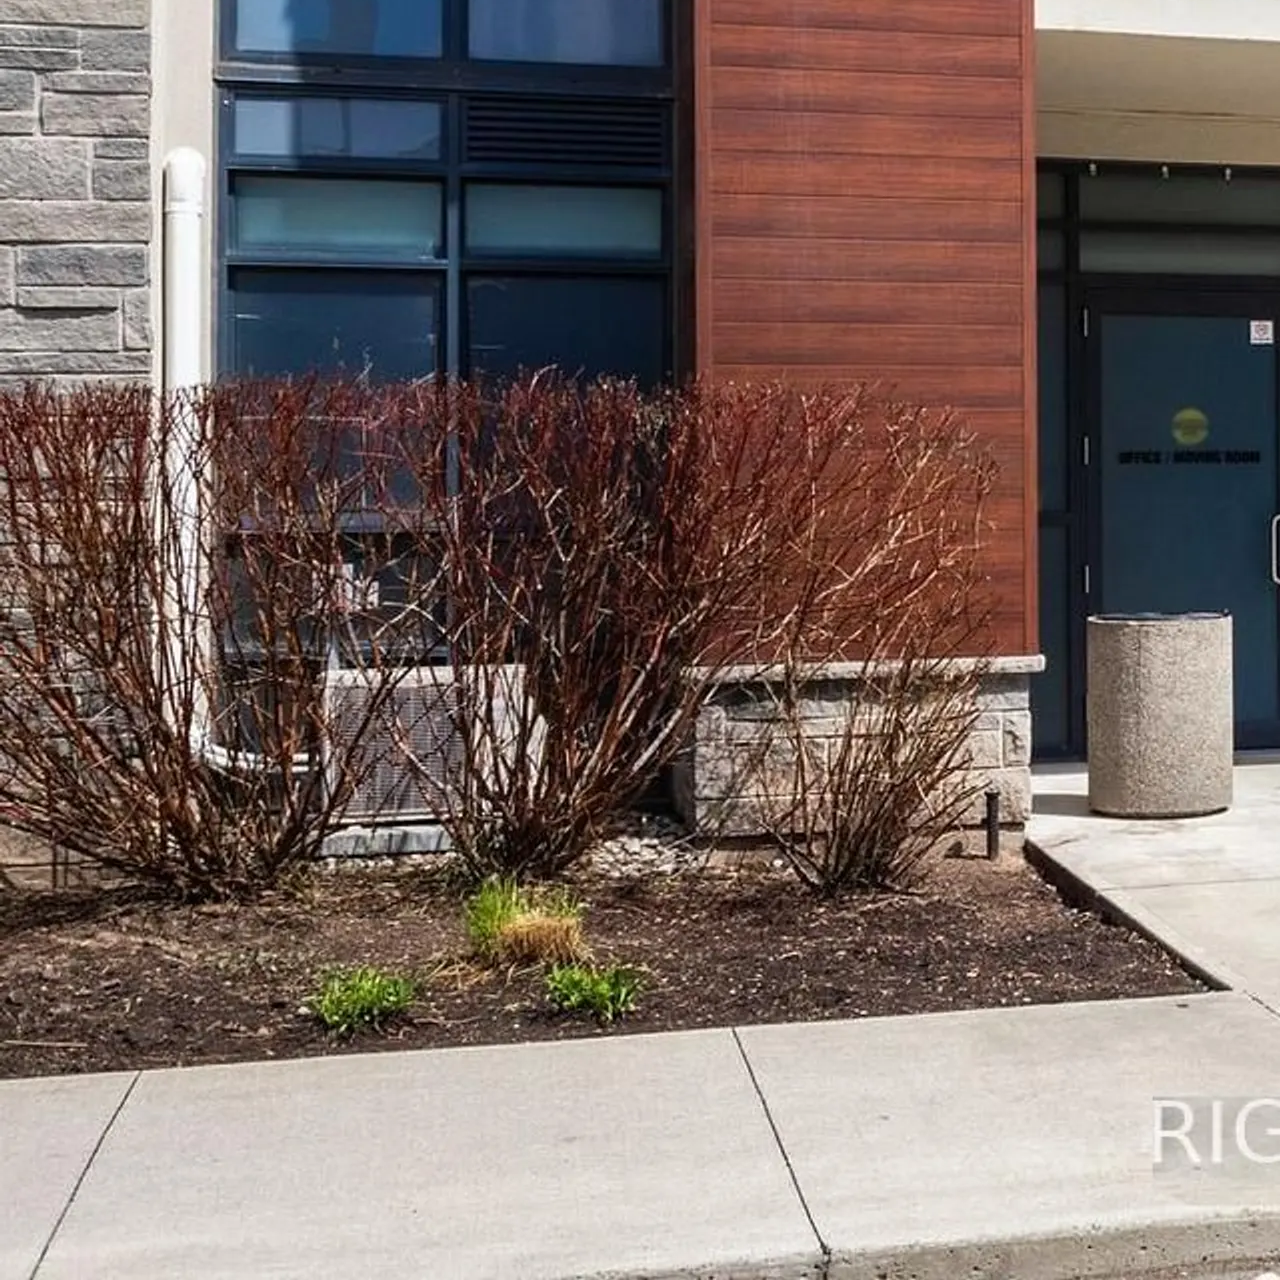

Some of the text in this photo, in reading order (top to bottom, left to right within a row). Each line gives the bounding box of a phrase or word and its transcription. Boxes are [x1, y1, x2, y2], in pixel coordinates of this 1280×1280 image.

[1119, 451, 1161, 464] OFFICE
[1173, 451, 1221, 464] MOVING
[1225, 451, 1260, 464] ROOM
